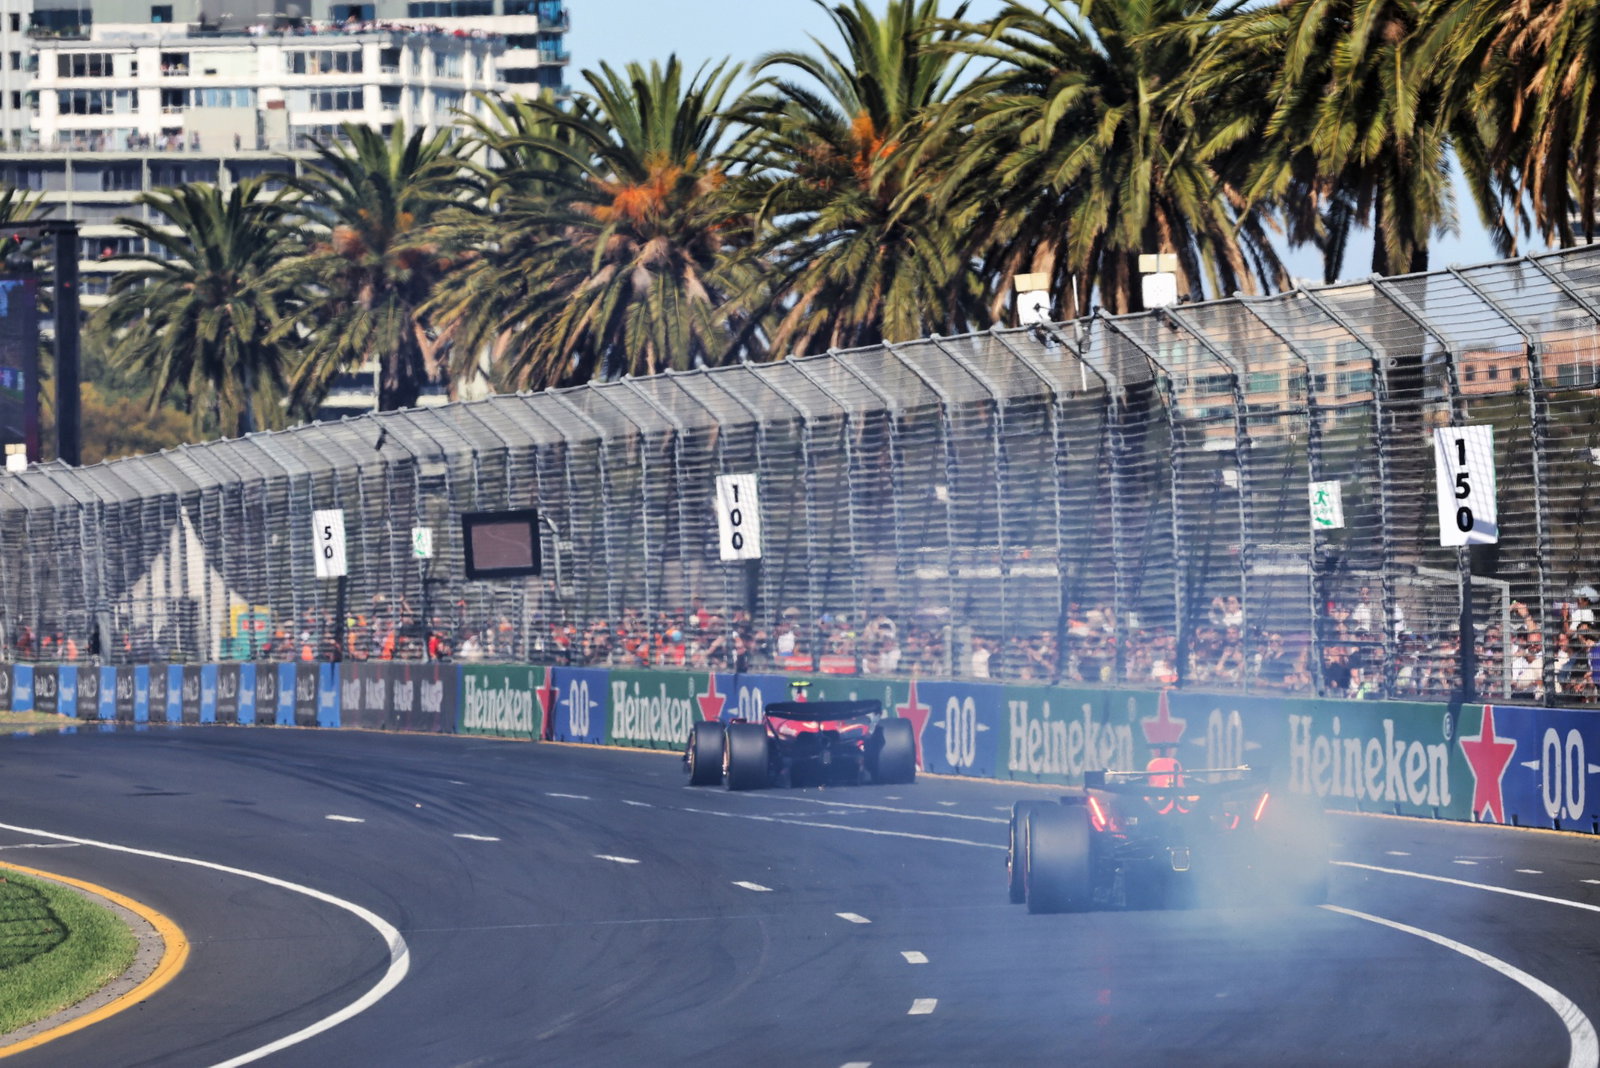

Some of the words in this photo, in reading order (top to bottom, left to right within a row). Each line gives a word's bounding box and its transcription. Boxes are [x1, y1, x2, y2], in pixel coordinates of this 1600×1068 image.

[731, 484, 744, 550] 100
[1455, 438, 1474, 532] 150
[324, 526, 334, 559] 50
[464, 675, 533, 732] Heineken
[611, 680, 694, 743] Heineken
[1008, 700, 1133, 777] Heineken
[1289, 714, 1452, 807] Heineken
[1542, 727, 1586, 820] 0.0
